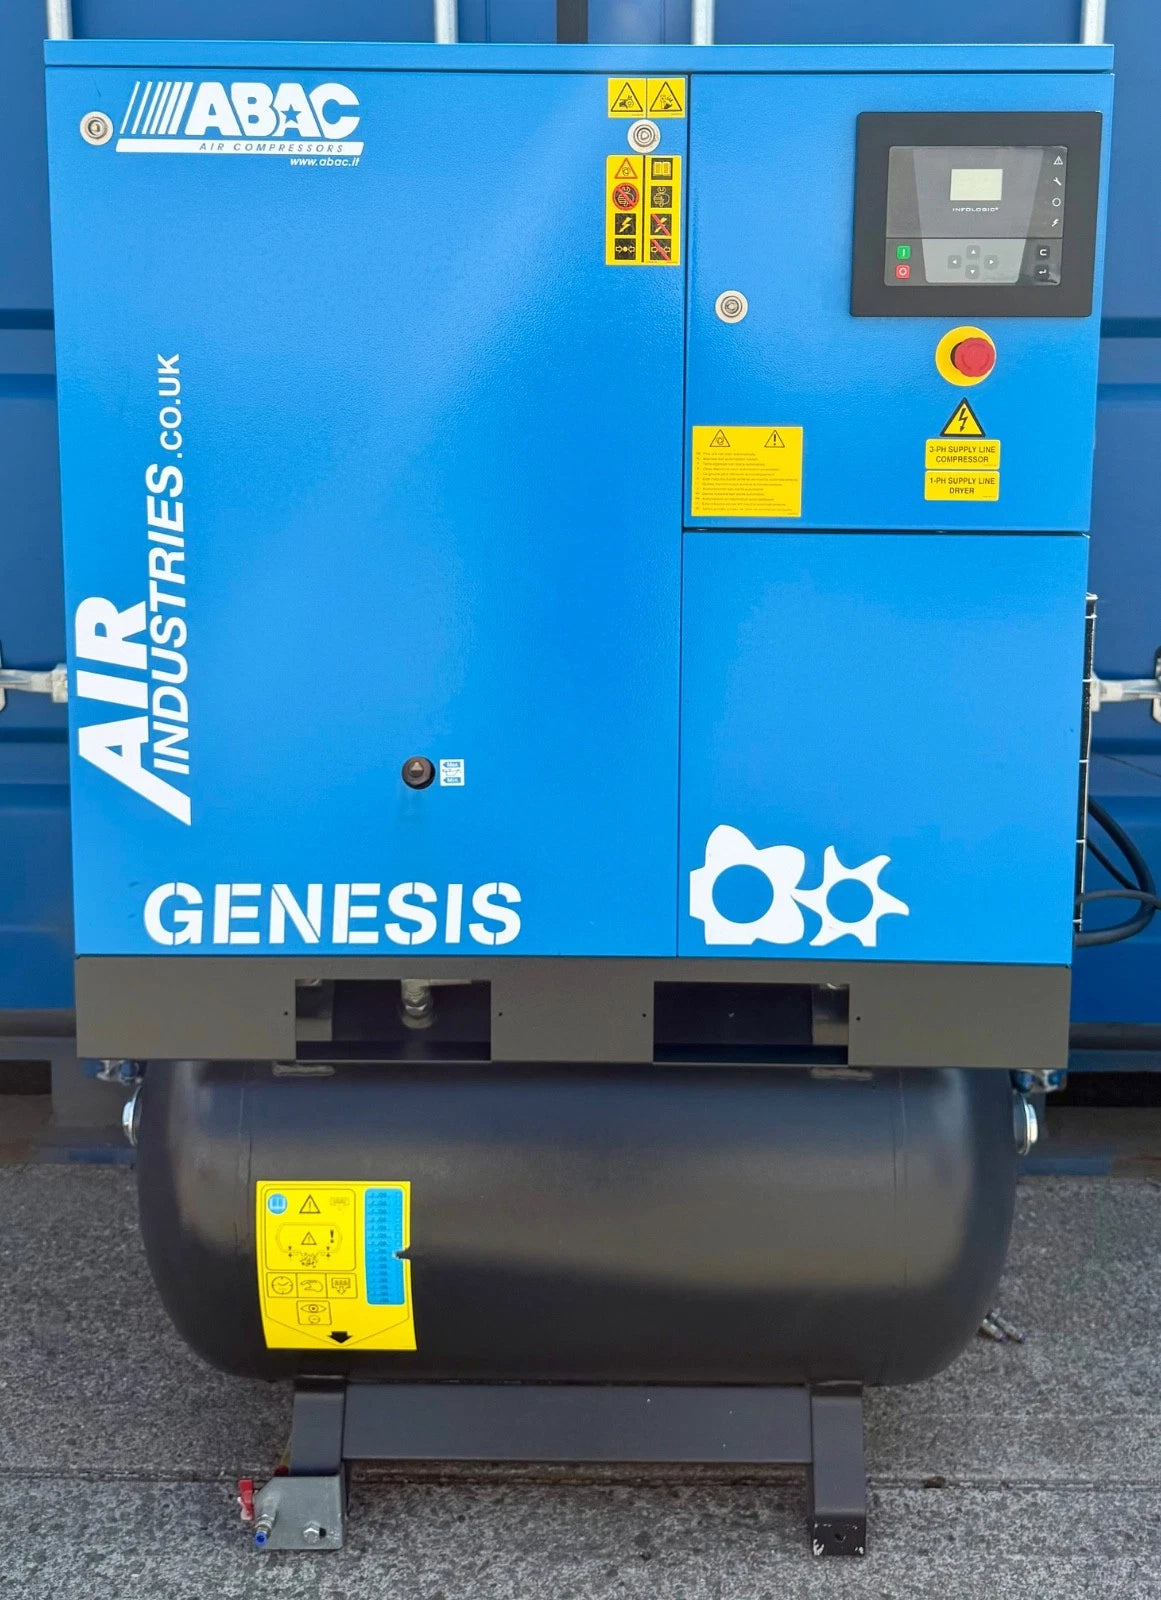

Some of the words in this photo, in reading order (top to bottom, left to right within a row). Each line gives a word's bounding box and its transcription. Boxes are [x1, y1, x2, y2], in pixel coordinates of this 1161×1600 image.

[184, 82, 360, 140] ABAC
[199, 142, 225, 152] AIR
[233, 143, 344, 154] COMPRESSORS
[290, 157, 360, 168] www.abac.it
[75, 596, 192, 826] AIR
[143, 882, 522, 946] GENESIS
